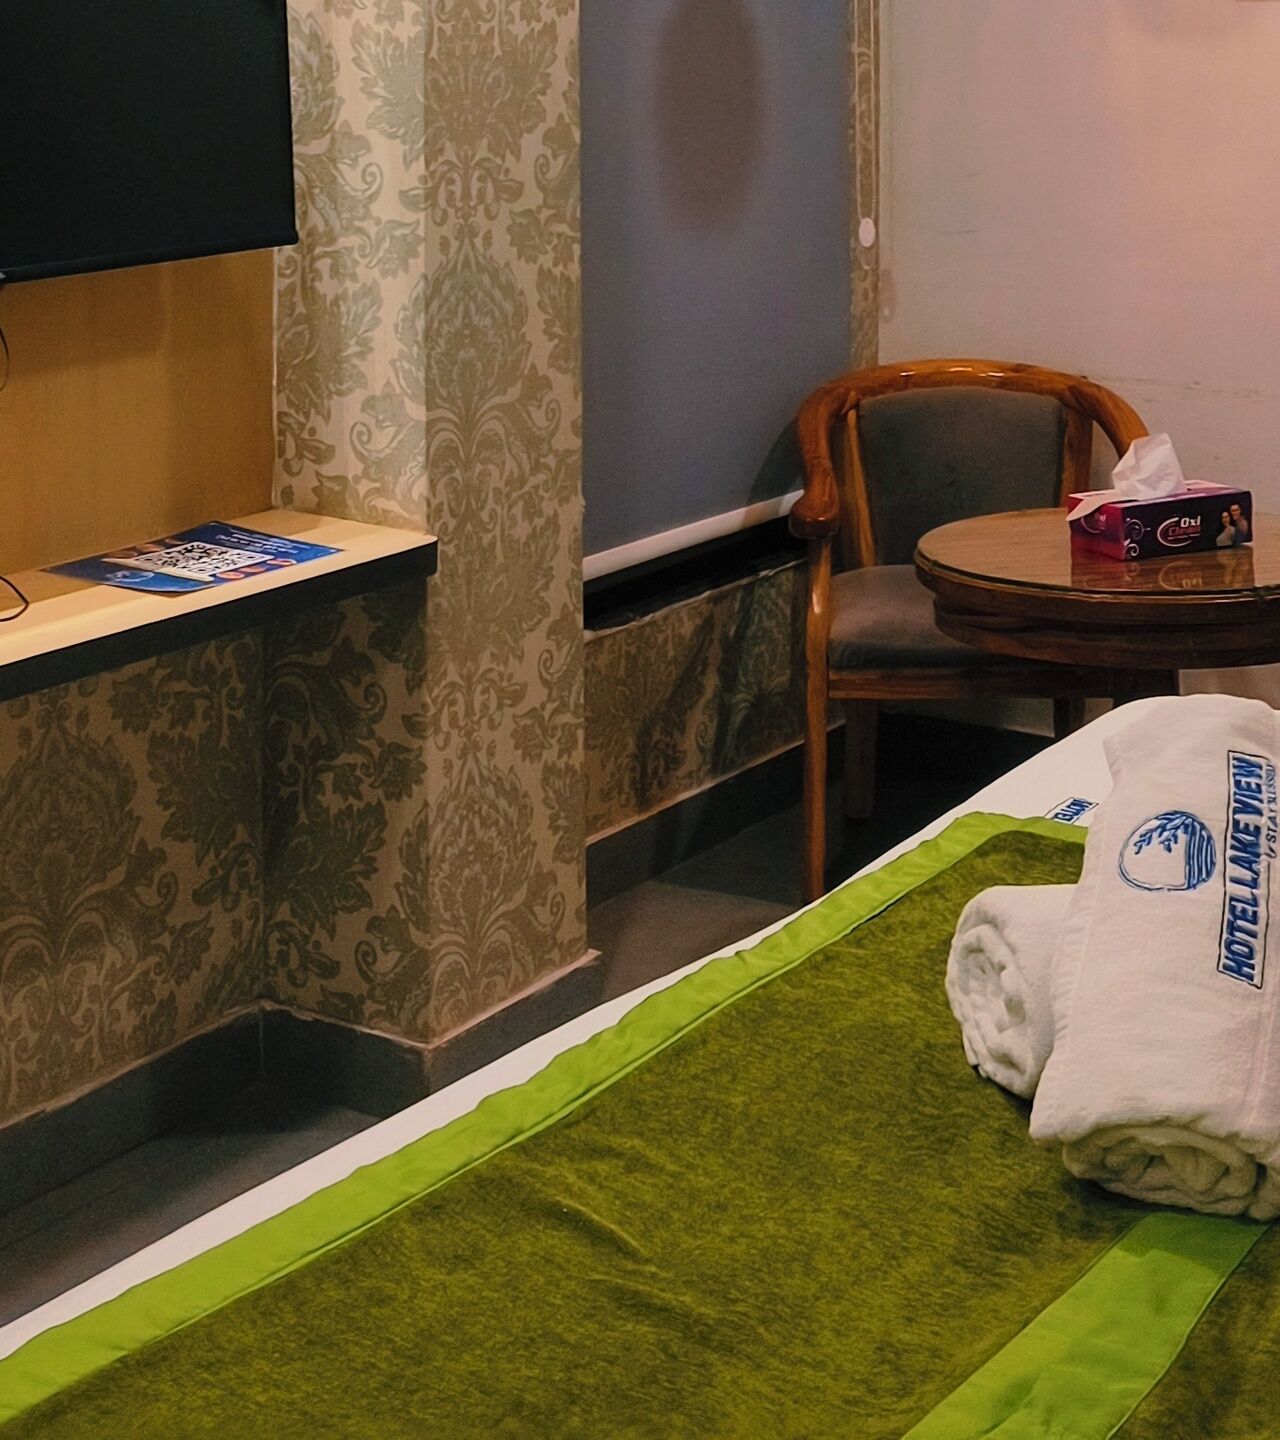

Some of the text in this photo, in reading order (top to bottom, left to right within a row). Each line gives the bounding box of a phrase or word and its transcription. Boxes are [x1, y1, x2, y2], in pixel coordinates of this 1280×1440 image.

[1223, 756, 1264, 982] HOTEL LAKE VIEW
